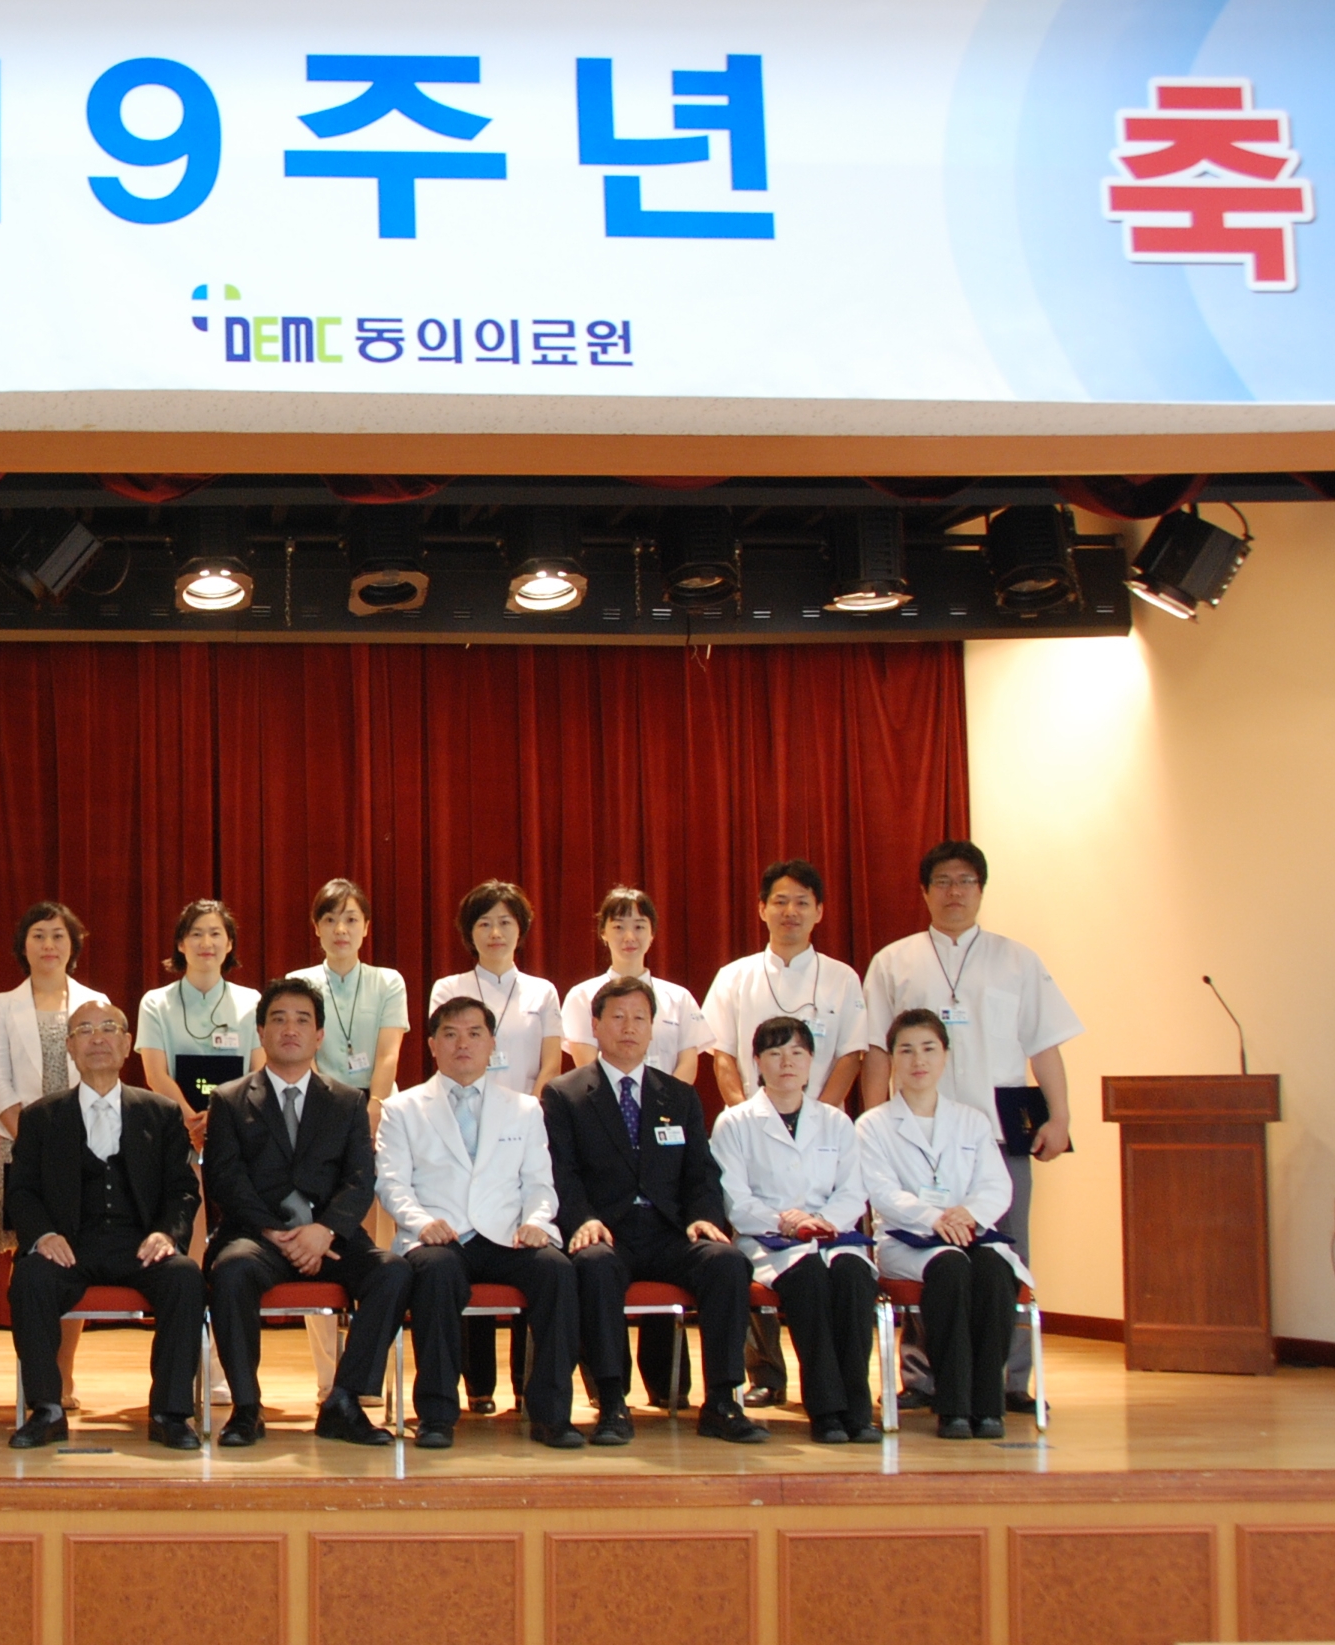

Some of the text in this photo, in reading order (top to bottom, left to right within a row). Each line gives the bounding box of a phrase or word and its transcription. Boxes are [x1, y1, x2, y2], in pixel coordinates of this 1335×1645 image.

[1111, 85, 1304, 282] 축
[224, 316, 635, 366] DEMC 동의의료원
